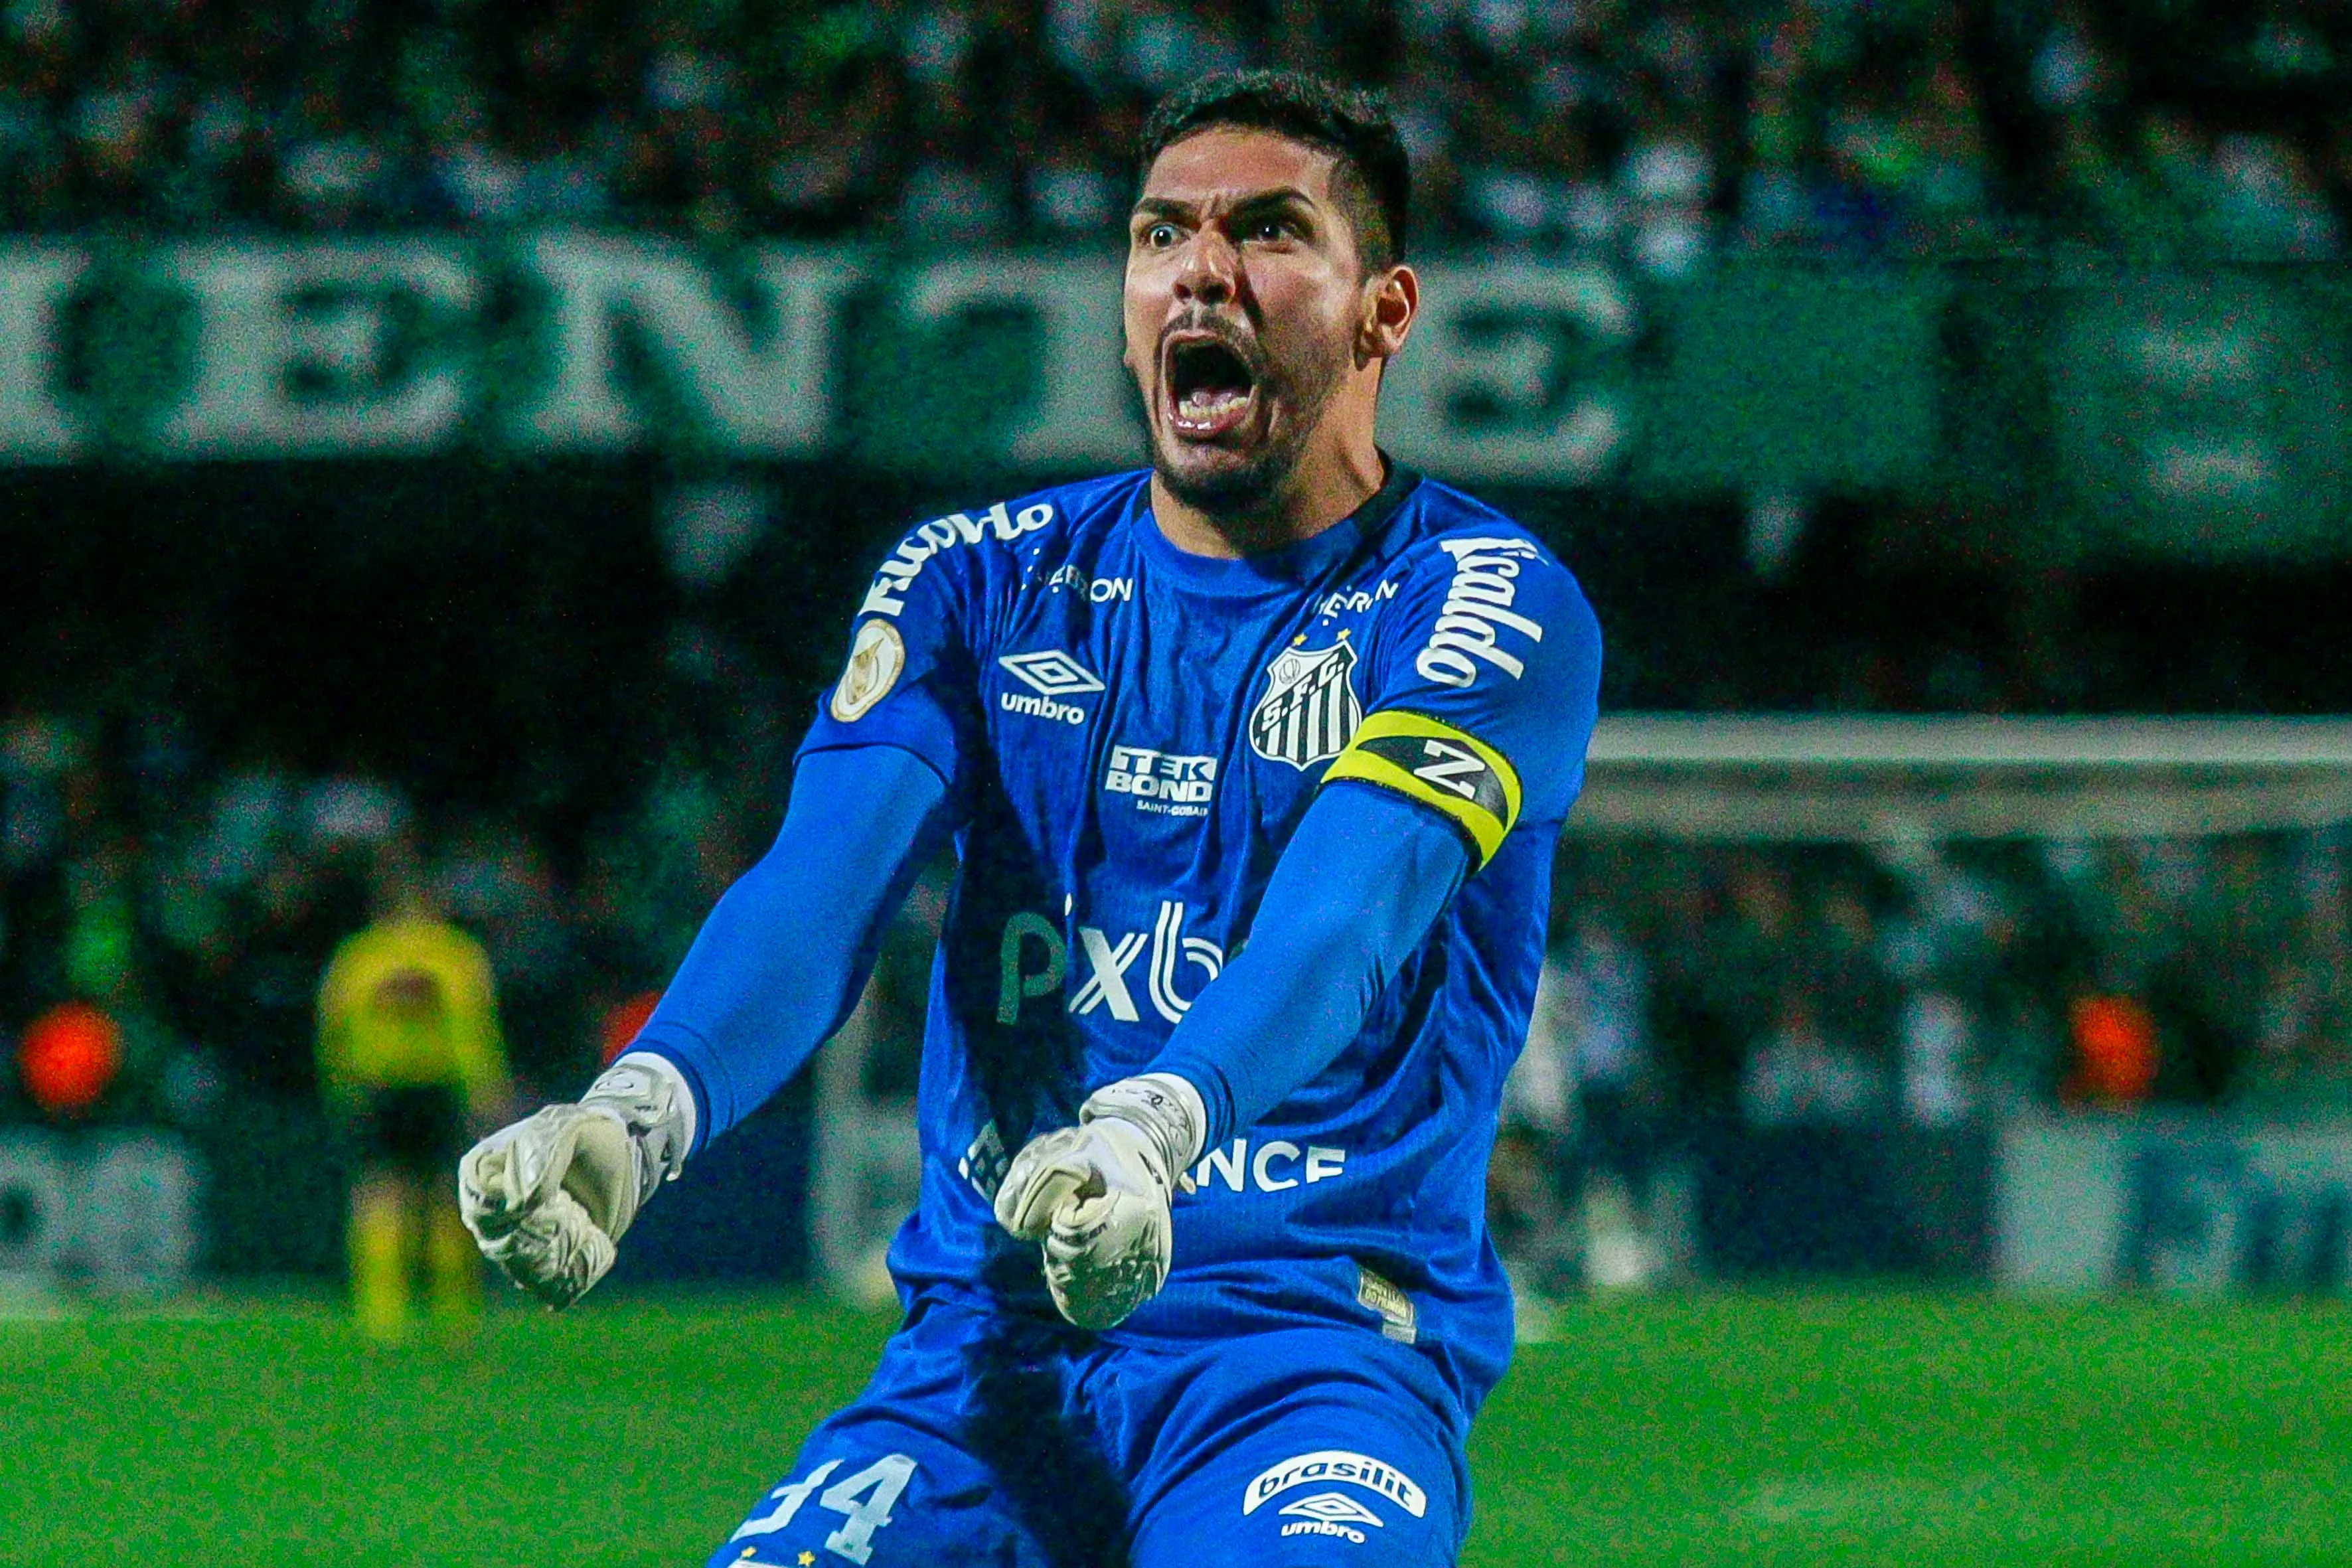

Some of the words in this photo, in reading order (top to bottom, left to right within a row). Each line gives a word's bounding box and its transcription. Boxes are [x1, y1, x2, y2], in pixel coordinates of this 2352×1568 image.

[1001, 692, 1085, 725] umbro
[1111, 745, 1217, 781] TEK
[1105, 770, 1213, 803] BOND
[1259, 1460, 1413, 1507] brasilit
[1281, 1521, 1366, 1543] umbro
